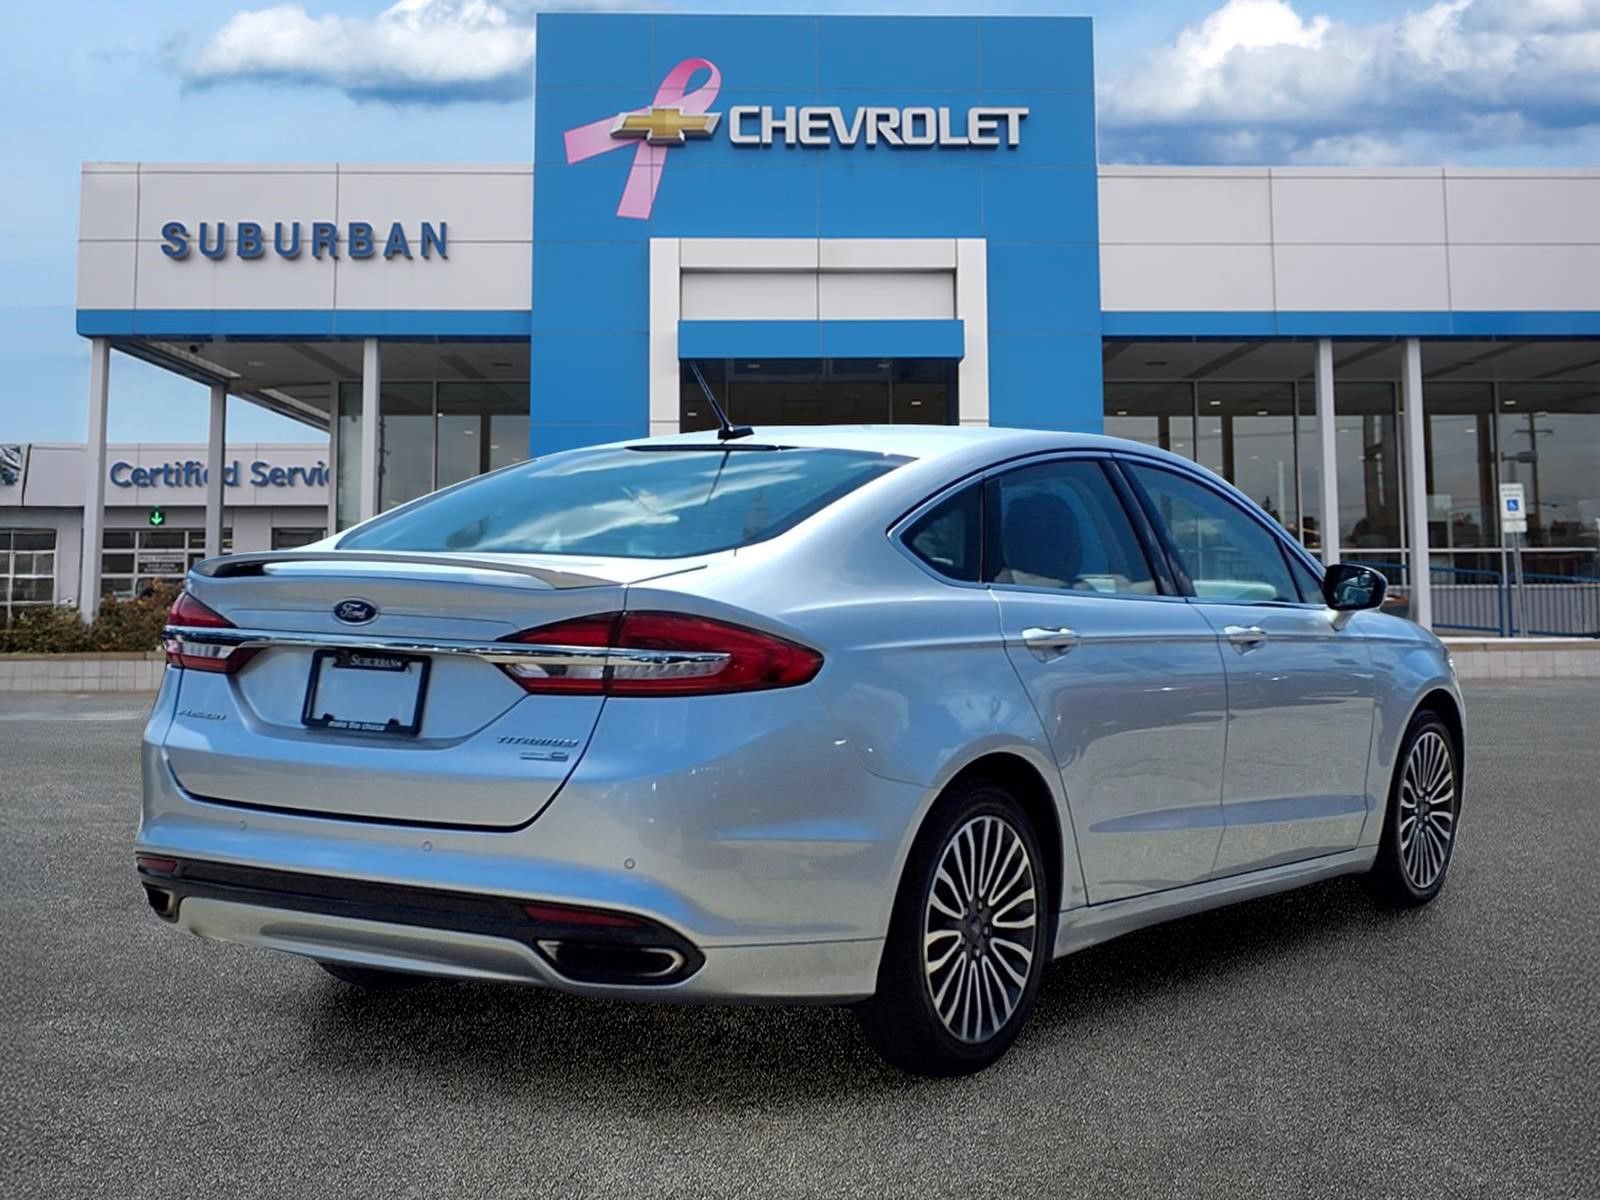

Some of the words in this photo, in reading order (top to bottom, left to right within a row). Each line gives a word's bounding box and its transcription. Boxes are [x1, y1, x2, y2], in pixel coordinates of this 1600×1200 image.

[729, 105, 1029, 145] CHEVROLET
[160, 221, 449, 260] SUBURBAN
[110, 461, 240, 488] Certifid
[250, 461, 329, 488] Servi
[497, 736, 579, 749] TITANIUM
